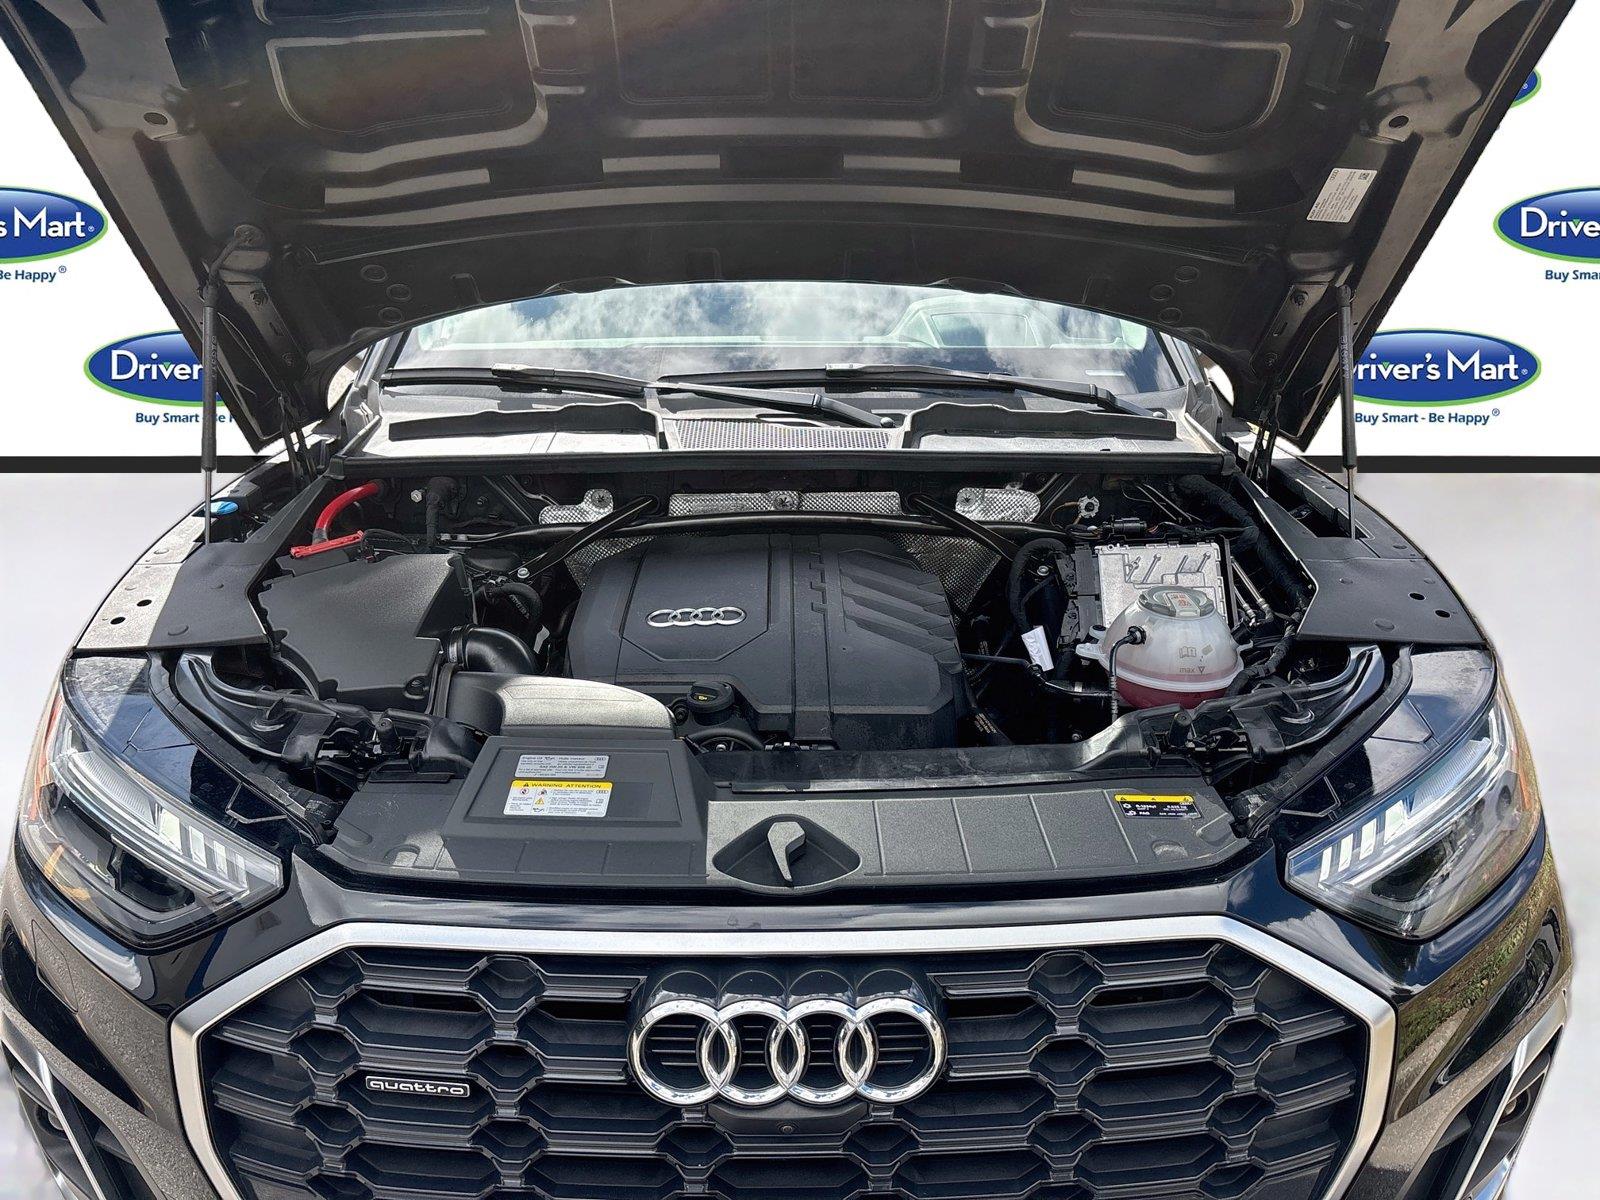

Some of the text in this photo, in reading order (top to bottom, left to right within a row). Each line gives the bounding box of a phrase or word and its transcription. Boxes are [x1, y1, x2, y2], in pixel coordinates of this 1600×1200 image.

[14, 206, 86, 238] Mart
[1520, 206, 1600, 238] Drive
[15, 270, 57, 283] Happy
[1545, 269, 1600, 283] Buy Sma
[111, 349, 204, 381] Driver
[1353, 352, 1441, 381] river's
[1447, 349, 1519, 381] Mart
[135, 412, 160, 426] Buy
[162, 412, 200, 423] Smart
[1355, 413, 1379, 426] Buy
[1382, 412, 1418, 423] Smart
[1428, 413, 1445, 423] Be
[1448, 413, 1490, 426] Happy
[369, 1080, 464, 1095] quattro
